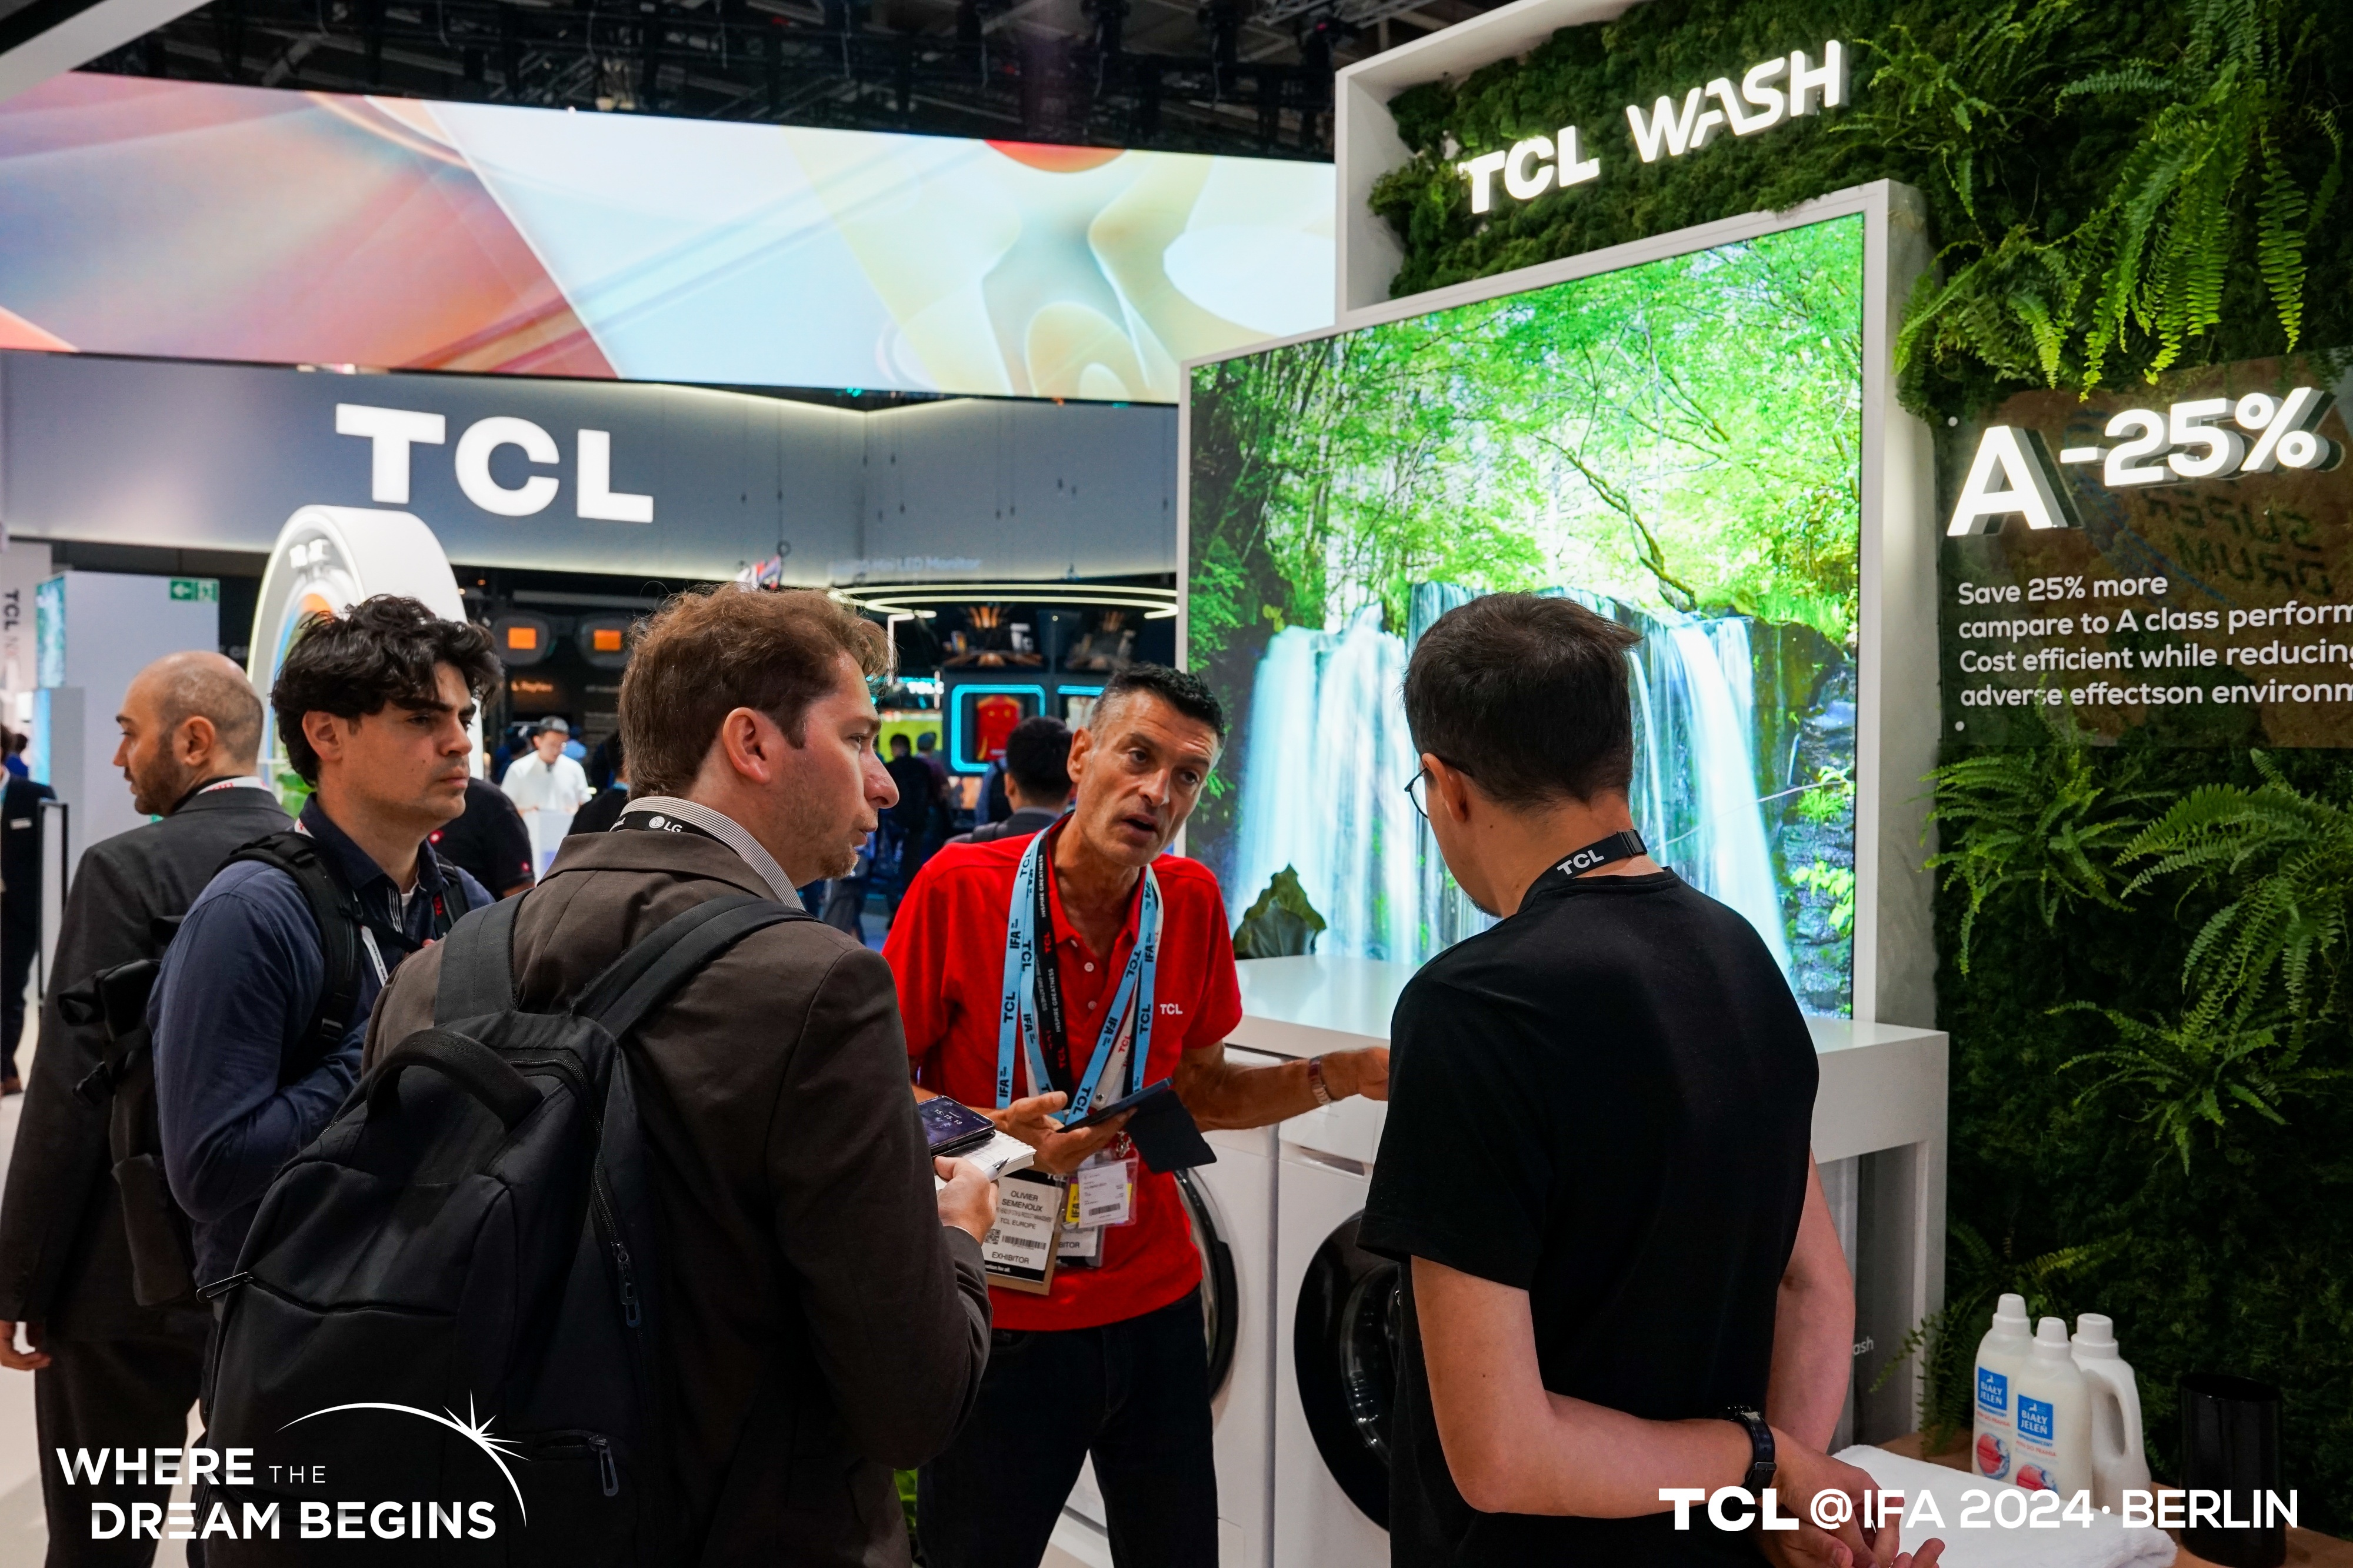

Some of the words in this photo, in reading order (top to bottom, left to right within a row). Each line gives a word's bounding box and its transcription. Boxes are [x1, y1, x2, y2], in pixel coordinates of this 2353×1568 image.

[1458, 125, 1600, 214] TCL
[1626, 39, 1842, 163] WASH
[336, 403, 654, 523] TCL
[1958, 582, 2021, 605] Save
[2028, 575, 2086, 601] 25%
[2093, 576, 2168, 598] more
[4, 589, 19, 631] TCL
[1958, 616, 2074, 643] campare
[2080, 613, 2109, 634] to
[2115, 609, 2139, 633] A
[2145, 607, 2219, 632] class
[2228, 600, 2353, 635] perform
[1959, 650, 2017, 673] Cost
[2022, 646, 2134, 672] efficient
[2139, 643, 2218, 668] while
[2227, 638, 2353, 670] reducin
[2069, 682, 2203, 705] effectson
[2212, 678, 2353, 705] environm
[663, 821, 683, 833] LG
[1019, 850, 1032, 878] TCL
[1557, 849, 1605, 875] TCL
[1009, 930, 1021, 949] IFA
[1043, 932, 1052, 953] TCL
[1021, 940, 1032, 972] TCL
[1125, 949, 1142, 978] TCL
[1145, 945, 1155, 963] IFA
[1004, 991, 1016, 1023] TCL
[1139, 1004, 1151, 1035] TCL
[1159, 1003, 1183, 1015] TCL
[1023, 1013, 1033, 1032] IFA
[1104, 1016, 1118, 1035] IFA
[1118, 1035, 1131, 1053] TCL
[999, 1079, 1009, 1098] IFA
[1072, 1086, 1092, 1115] TCL
[1001, 1198, 1044, 1212] SEMENOUX
[1010, 1190, 1039, 1201] OLIVIER
[991, 1251, 1030, 1265] EXHIBITOR
[1853, 1335, 1875, 1356] ash
